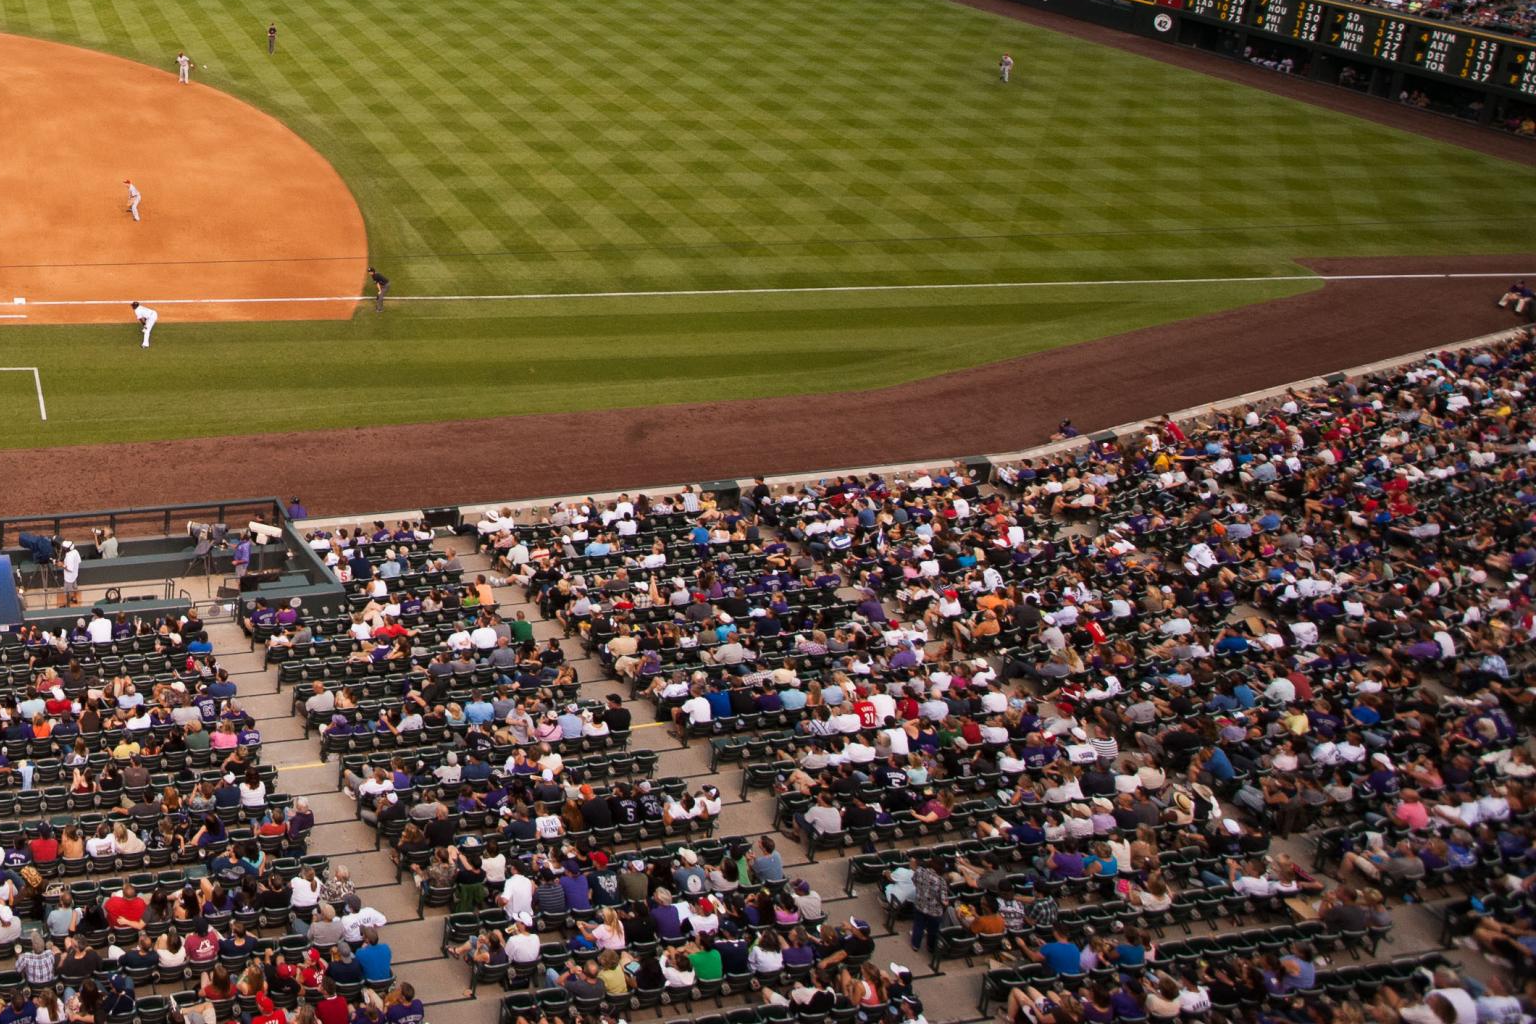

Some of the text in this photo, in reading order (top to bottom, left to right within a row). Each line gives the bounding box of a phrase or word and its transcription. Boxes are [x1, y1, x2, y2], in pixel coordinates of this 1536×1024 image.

[1195, 5, 1241, 23] SF 75
[1197, 0, 1243, 15] LAD 58
[1268, 4, 1320, 22] HOU 30
[1307, 3, 1322, 13] 51
[1157, 19, 1168, 29] 42
[1263, 23, 1279, 33] ATL
[1266, 14, 1317, 32] PHI 56
[1345, 21, 1402, 41] MIA 23
[1347, 12, 1405, 32] SD 59
[1343, 31, 1400, 51] WSH 27
[1432, 30, 1497, 52] NYM 55
[1340, 40, 1397, 61] MIL 43
[1429, 41, 1494, 61] ARI 31
[1427, 50, 1492, 72] DET 19
[1424, 60, 1489, 82] TOR 37
[864, 712, 874, 724] 31
[627, 807, 634, 821] 5
